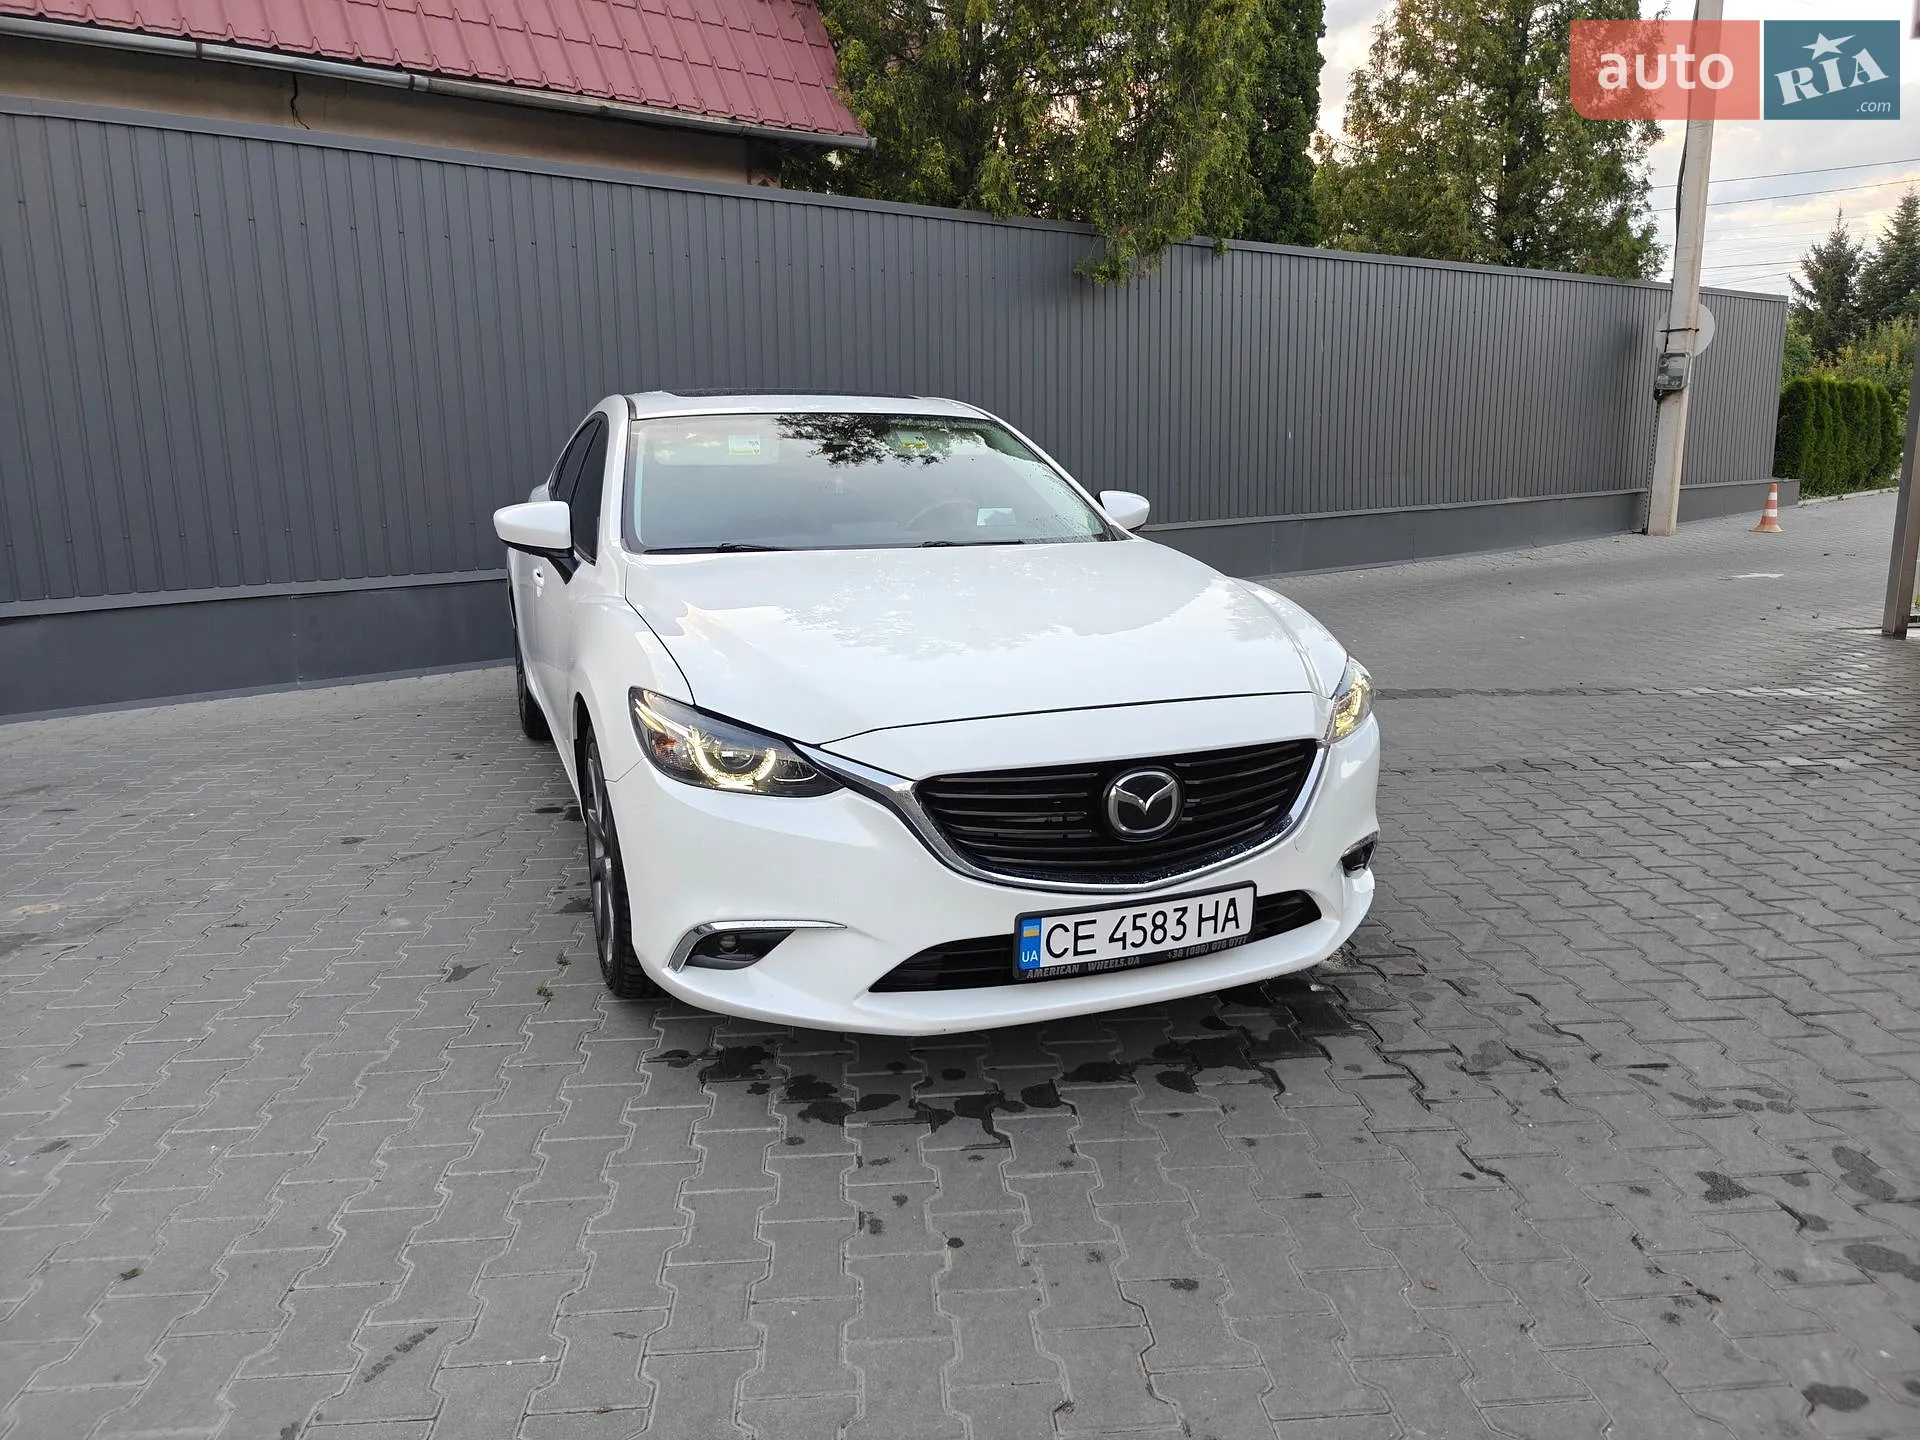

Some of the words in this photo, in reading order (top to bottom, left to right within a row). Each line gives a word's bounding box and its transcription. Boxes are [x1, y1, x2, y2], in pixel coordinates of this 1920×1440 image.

[1045, 919, 1097, 959] CE
[1108, 906, 1189, 951] 4583
[1197, 897, 1240, 938] HA
[1022, 950, 1039, 963] UA
[1026, 964, 1080, 979] AMERICAN
[1087, 956, 1141, 972] WHEELS.UA
